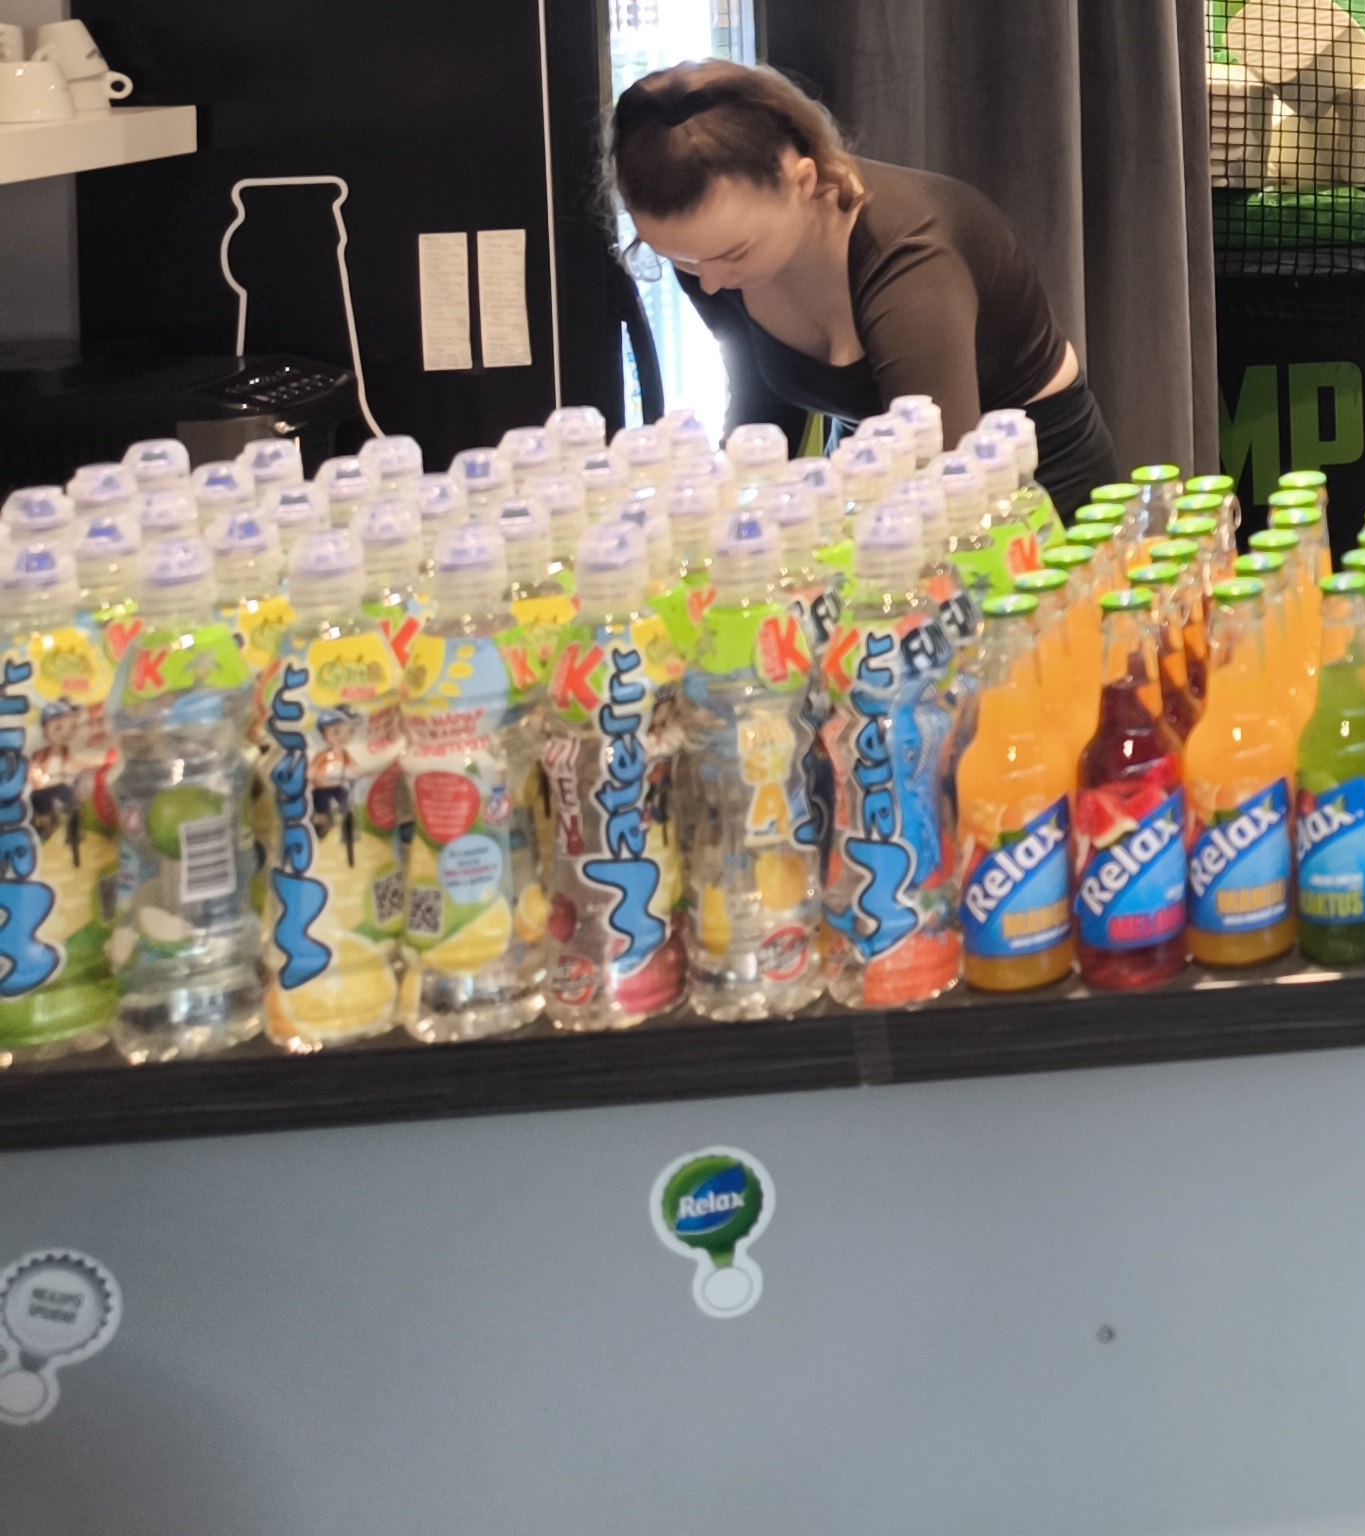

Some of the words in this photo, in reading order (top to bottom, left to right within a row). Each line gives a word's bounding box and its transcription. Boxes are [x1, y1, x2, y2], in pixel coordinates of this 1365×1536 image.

[965, 815, 1066, 924] Relax
[1081, 810, 1181, 916] Relax
[1190, 794, 1282, 897] Relax
[680, 1190, 745, 1219] Relax
